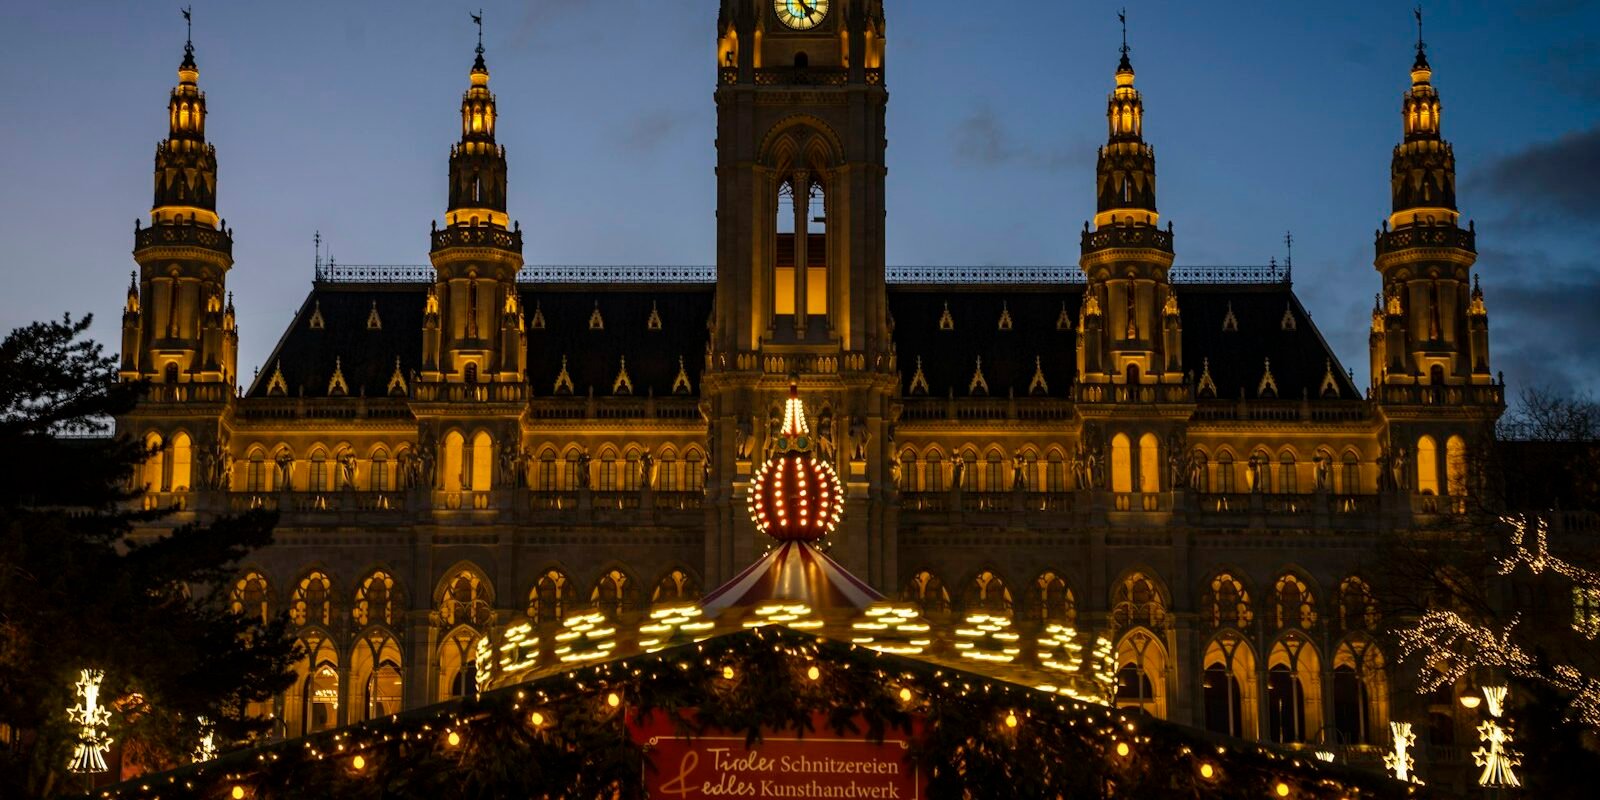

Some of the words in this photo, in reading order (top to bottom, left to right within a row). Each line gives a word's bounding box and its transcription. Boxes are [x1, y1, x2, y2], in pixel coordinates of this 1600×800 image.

[660, 751, 700, 799] &
[701, 773, 756, 796] edles
[760, 780, 899, 799] Kunsthandwerk
[706, 748, 775, 772] Tiroler
[780, 756, 899, 774] Schnitzereien
